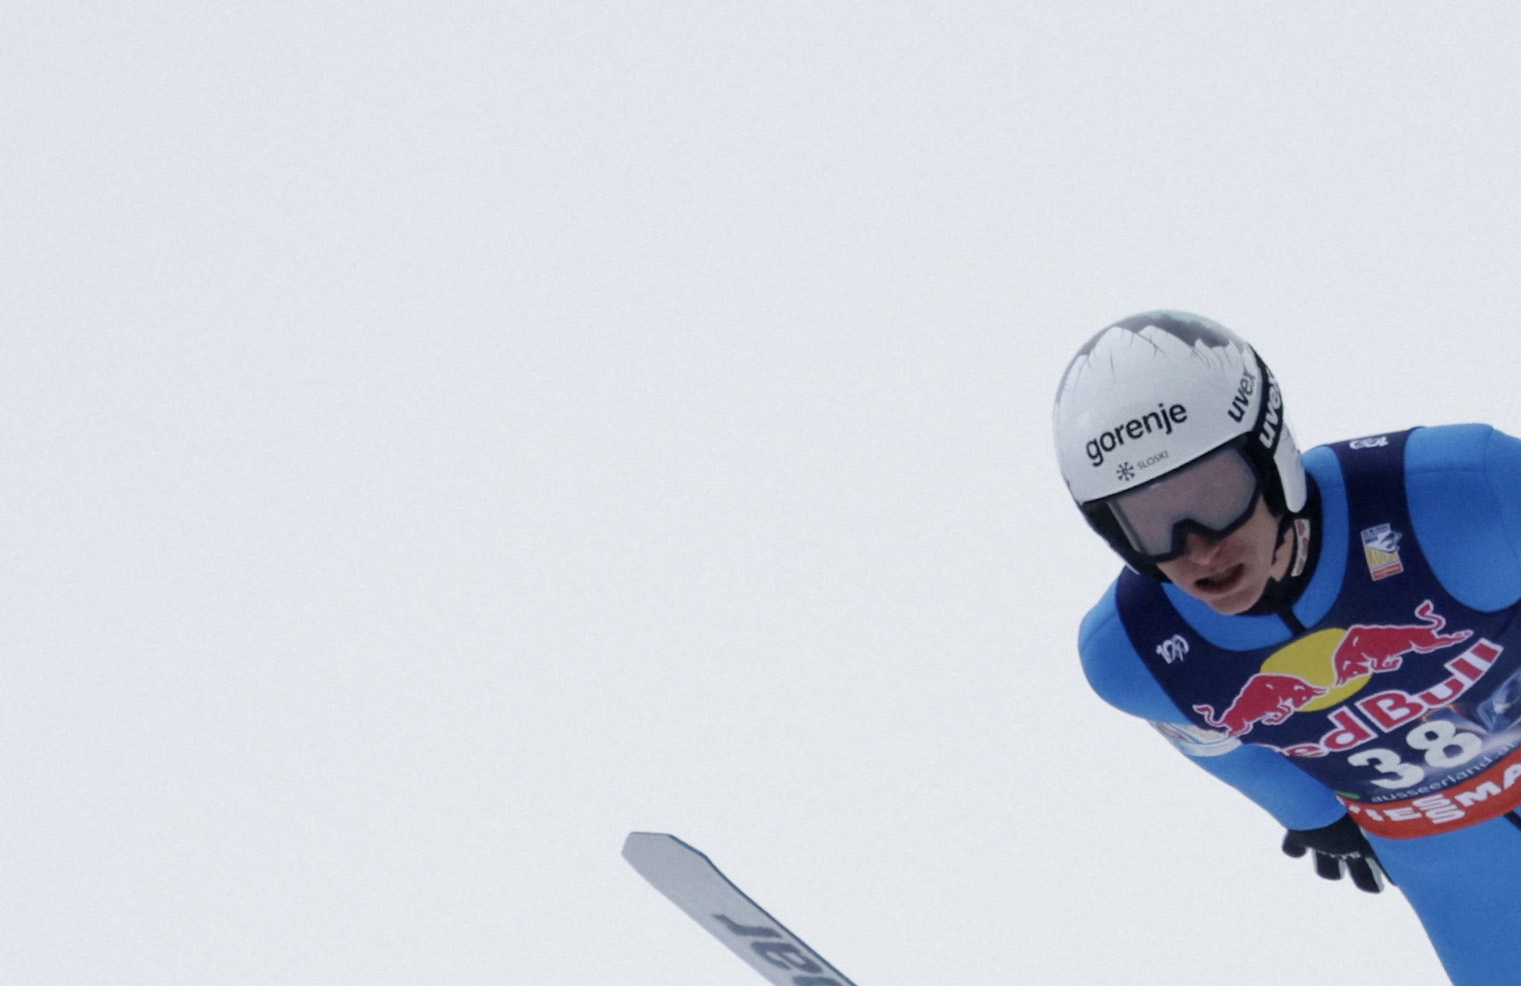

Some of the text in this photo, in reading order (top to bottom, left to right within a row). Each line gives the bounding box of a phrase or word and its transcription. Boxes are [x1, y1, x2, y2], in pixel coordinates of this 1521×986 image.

[1227, 366, 1256, 424] uvex
[1085, 402, 1188, 467] gorenje
[1282, 638, 1503, 758] ed Bull
[1347, 719, 1483, 789] 38
